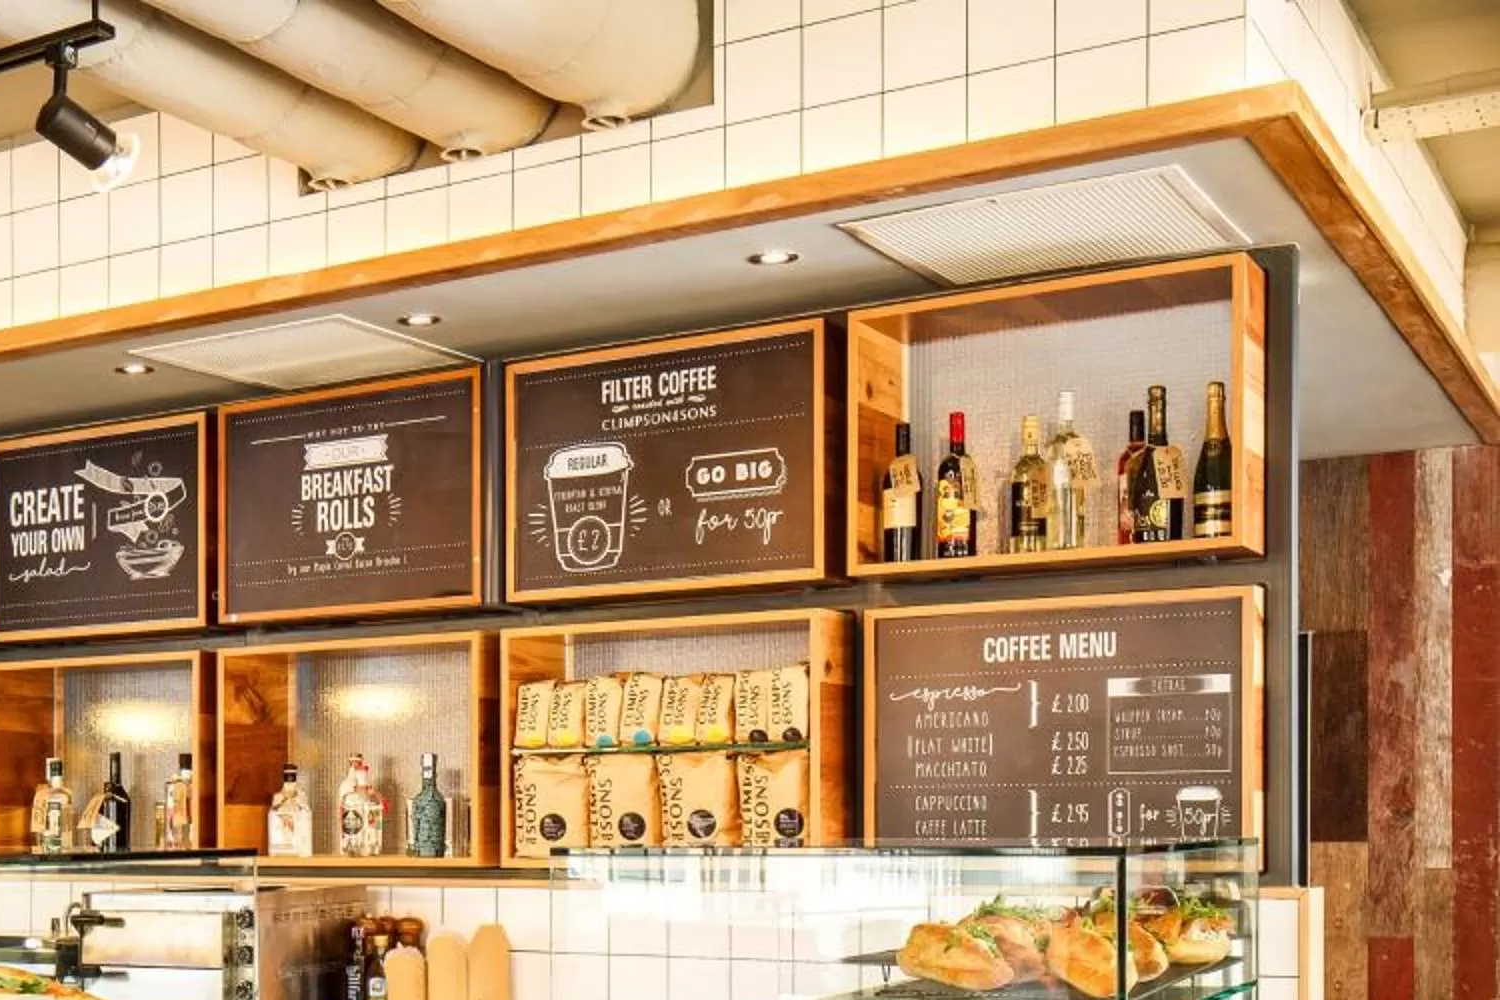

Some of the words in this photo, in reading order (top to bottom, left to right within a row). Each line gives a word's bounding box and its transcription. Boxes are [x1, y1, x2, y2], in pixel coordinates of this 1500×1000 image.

[601, 374, 653, 404] FILTER
[658, 365, 717, 397] COFFEE
[301, 464, 395, 501] BREAKFAST
[696, 464, 726, 485] GO
[734, 460, 774, 481] BIG
[9, 483, 86, 528] CREATE
[316, 496, 376, 533] ROLLS
[10, 529, 49, 558] YOUR
[51, 525, 86, 553] OWN
[9, 557, 92, 583] salad
[983, 634, 1051, 663] COFFEE
[1059, 631, 1117, 659] MENU
[915, 711, 990, 729] AMERICANO
[915, 736, 943, 755] FLAT
[950, 734, 989, 754] WHITE
[915, 761, 989, 779] MACCHIATO
[915, 795, 989, 812] CAPPUCCINO
[952, 819, 989, 836] LATTE
